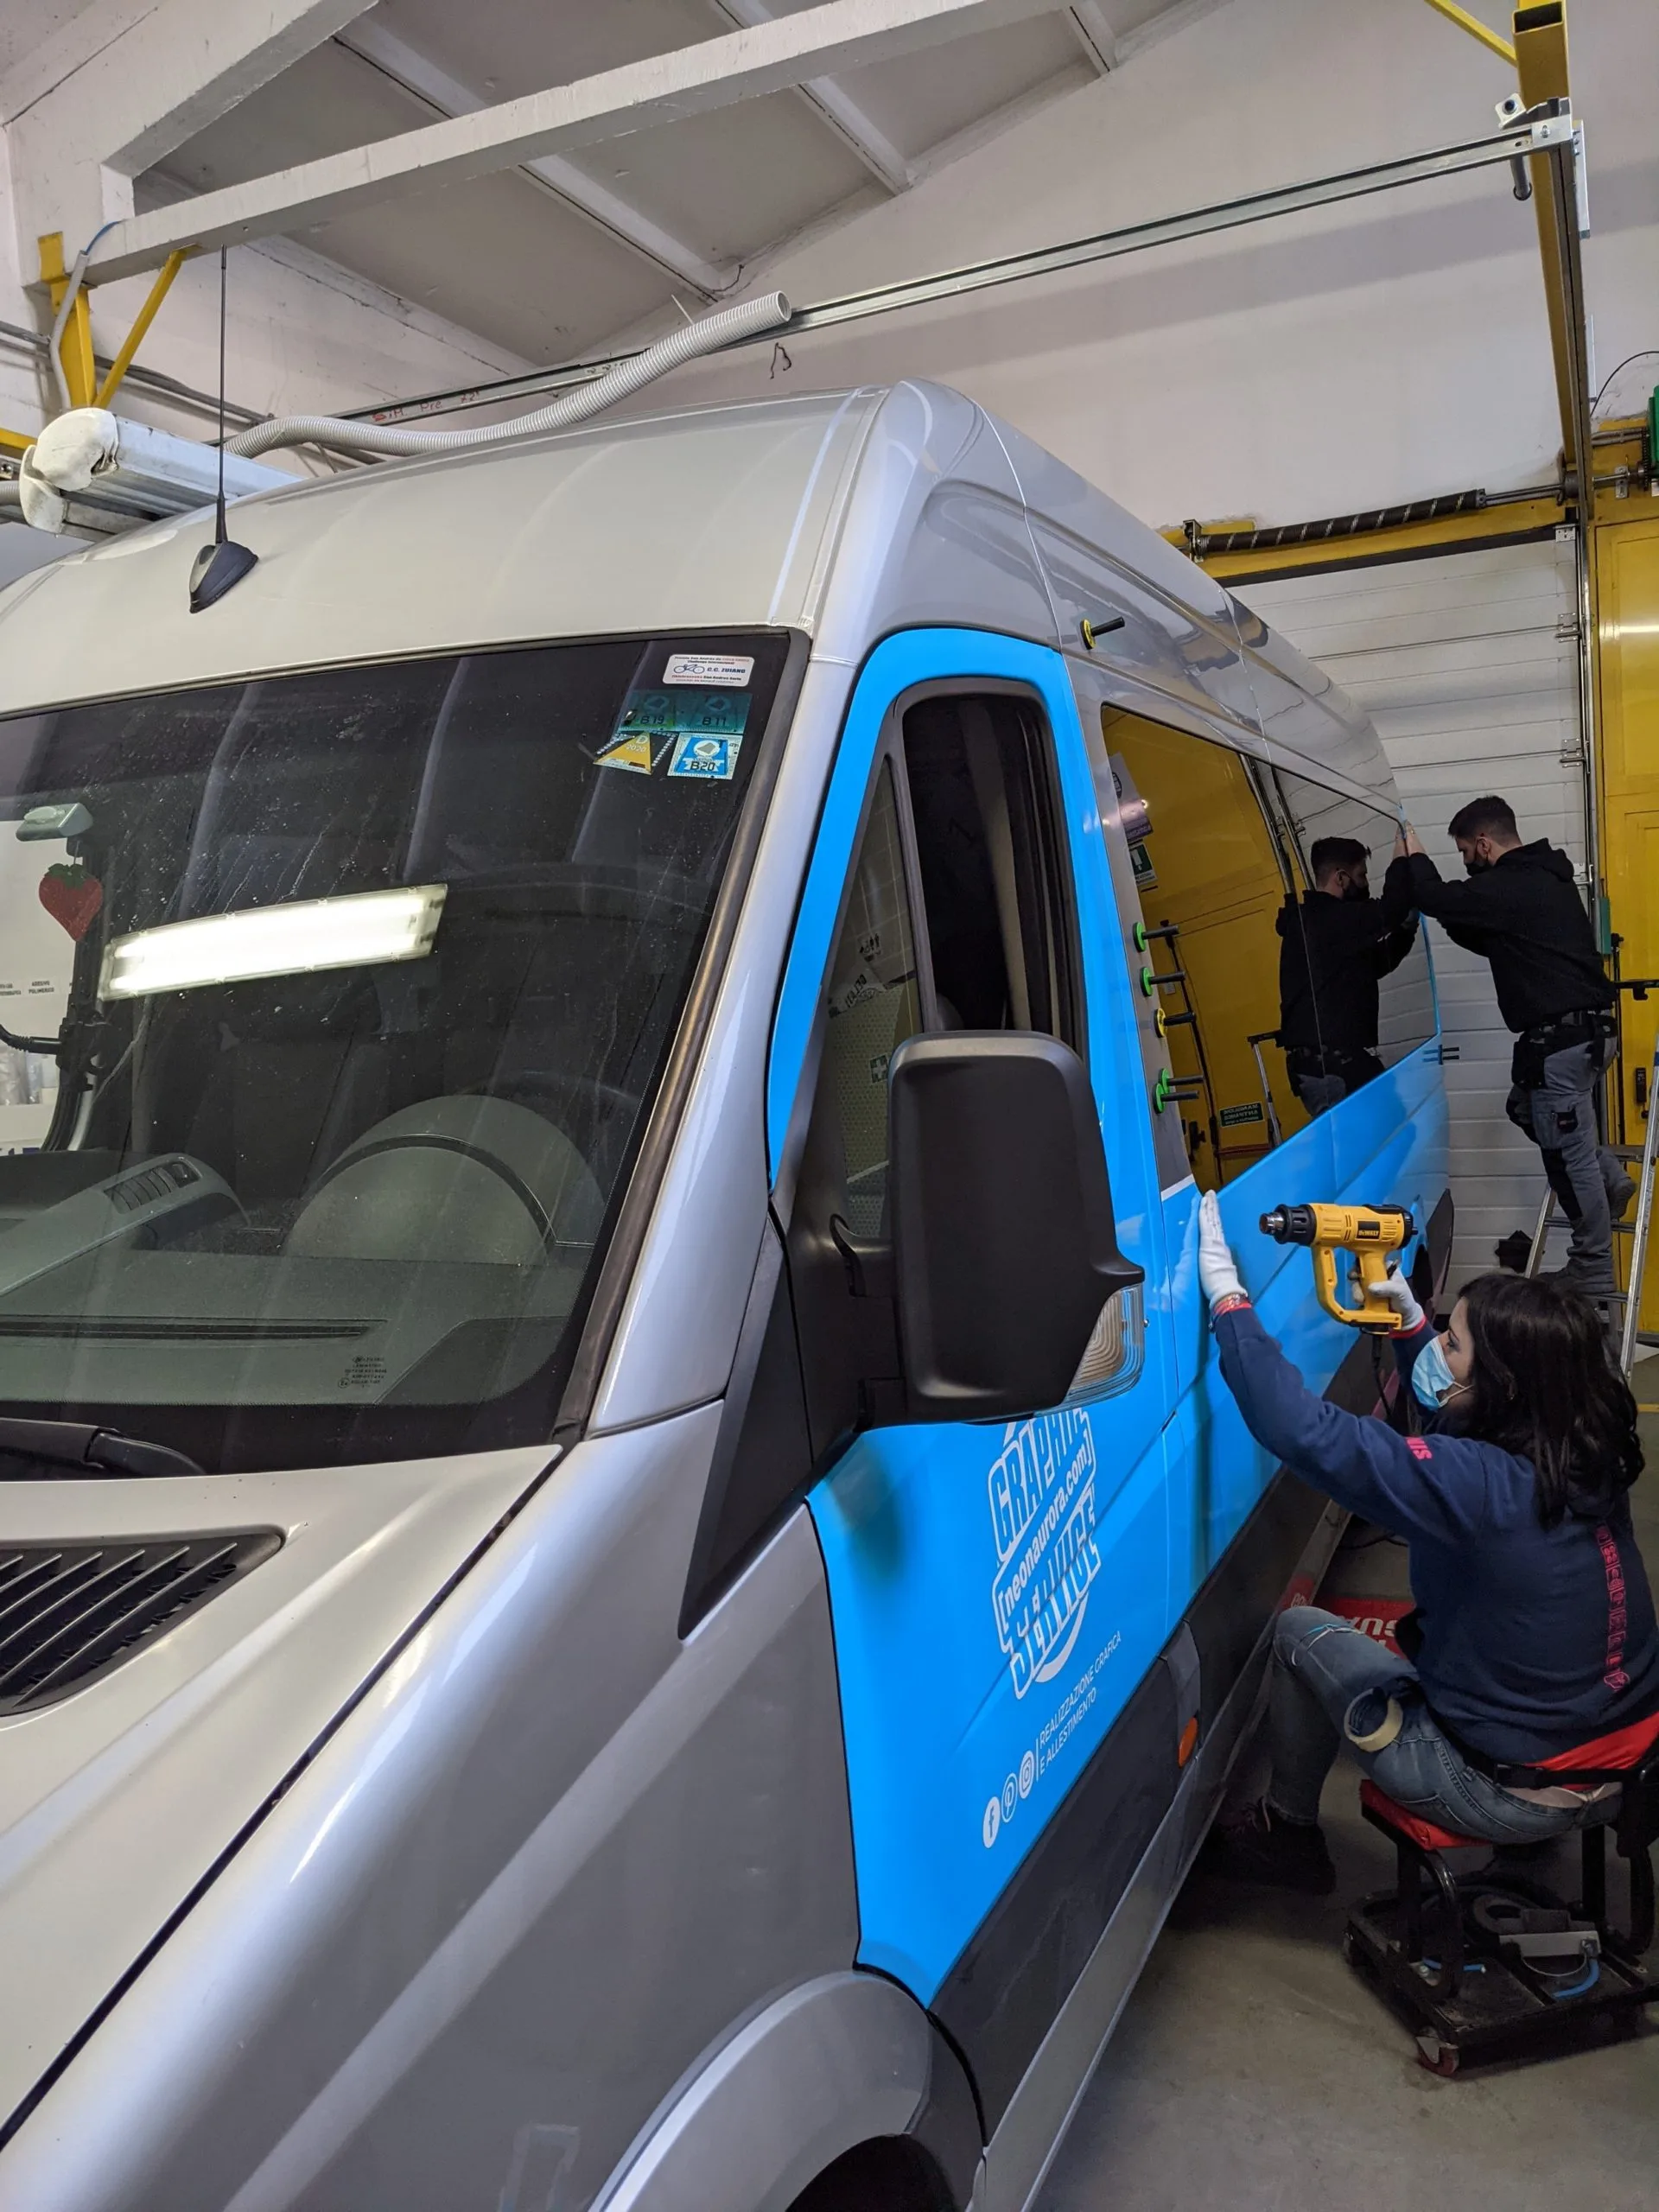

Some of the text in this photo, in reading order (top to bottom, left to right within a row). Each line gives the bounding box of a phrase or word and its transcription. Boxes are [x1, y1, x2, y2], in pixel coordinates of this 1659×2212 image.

[625, 743, 647, 753] 2020
[998, 1427, 1091, 1635] [neonaurora.com]
[1039, 1630, 1122, 1749] REALIZZAZIONE GRAFICA
[1039, 1687, 1097, 1776] E ALLESTIMENTO
